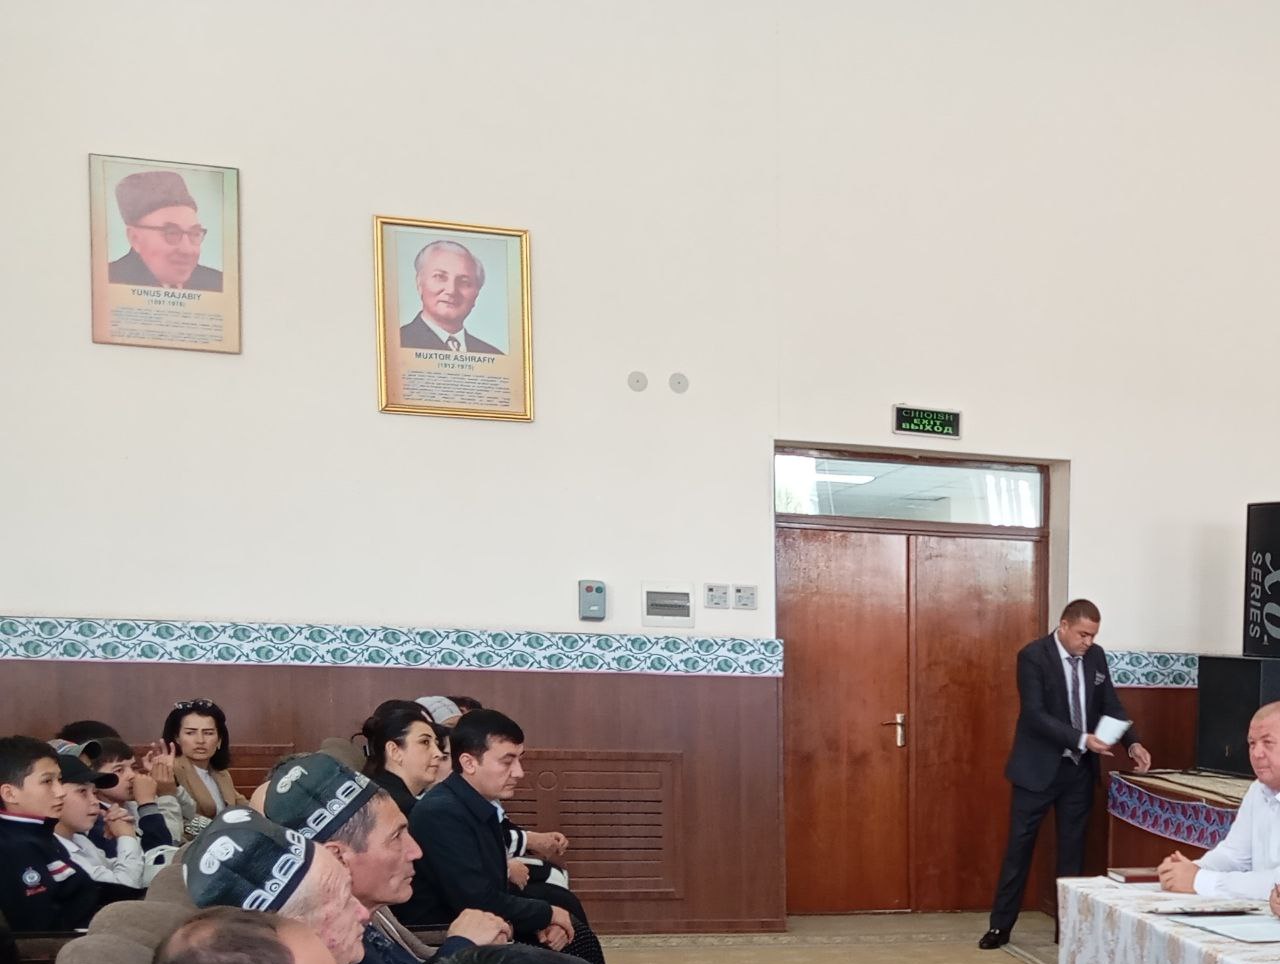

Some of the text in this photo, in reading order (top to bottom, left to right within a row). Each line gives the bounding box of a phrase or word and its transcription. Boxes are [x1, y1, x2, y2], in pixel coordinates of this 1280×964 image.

[130, 288, 202, 301] YUNUS RAJABIY
[415, 351, 496, 364] MUXTOR ASHRAFIY
[901, 422, 953, 434] ВЫХОД
[913, 418, 942, 426] EXIT
[1249, 550, 1263, 639] SERIES
